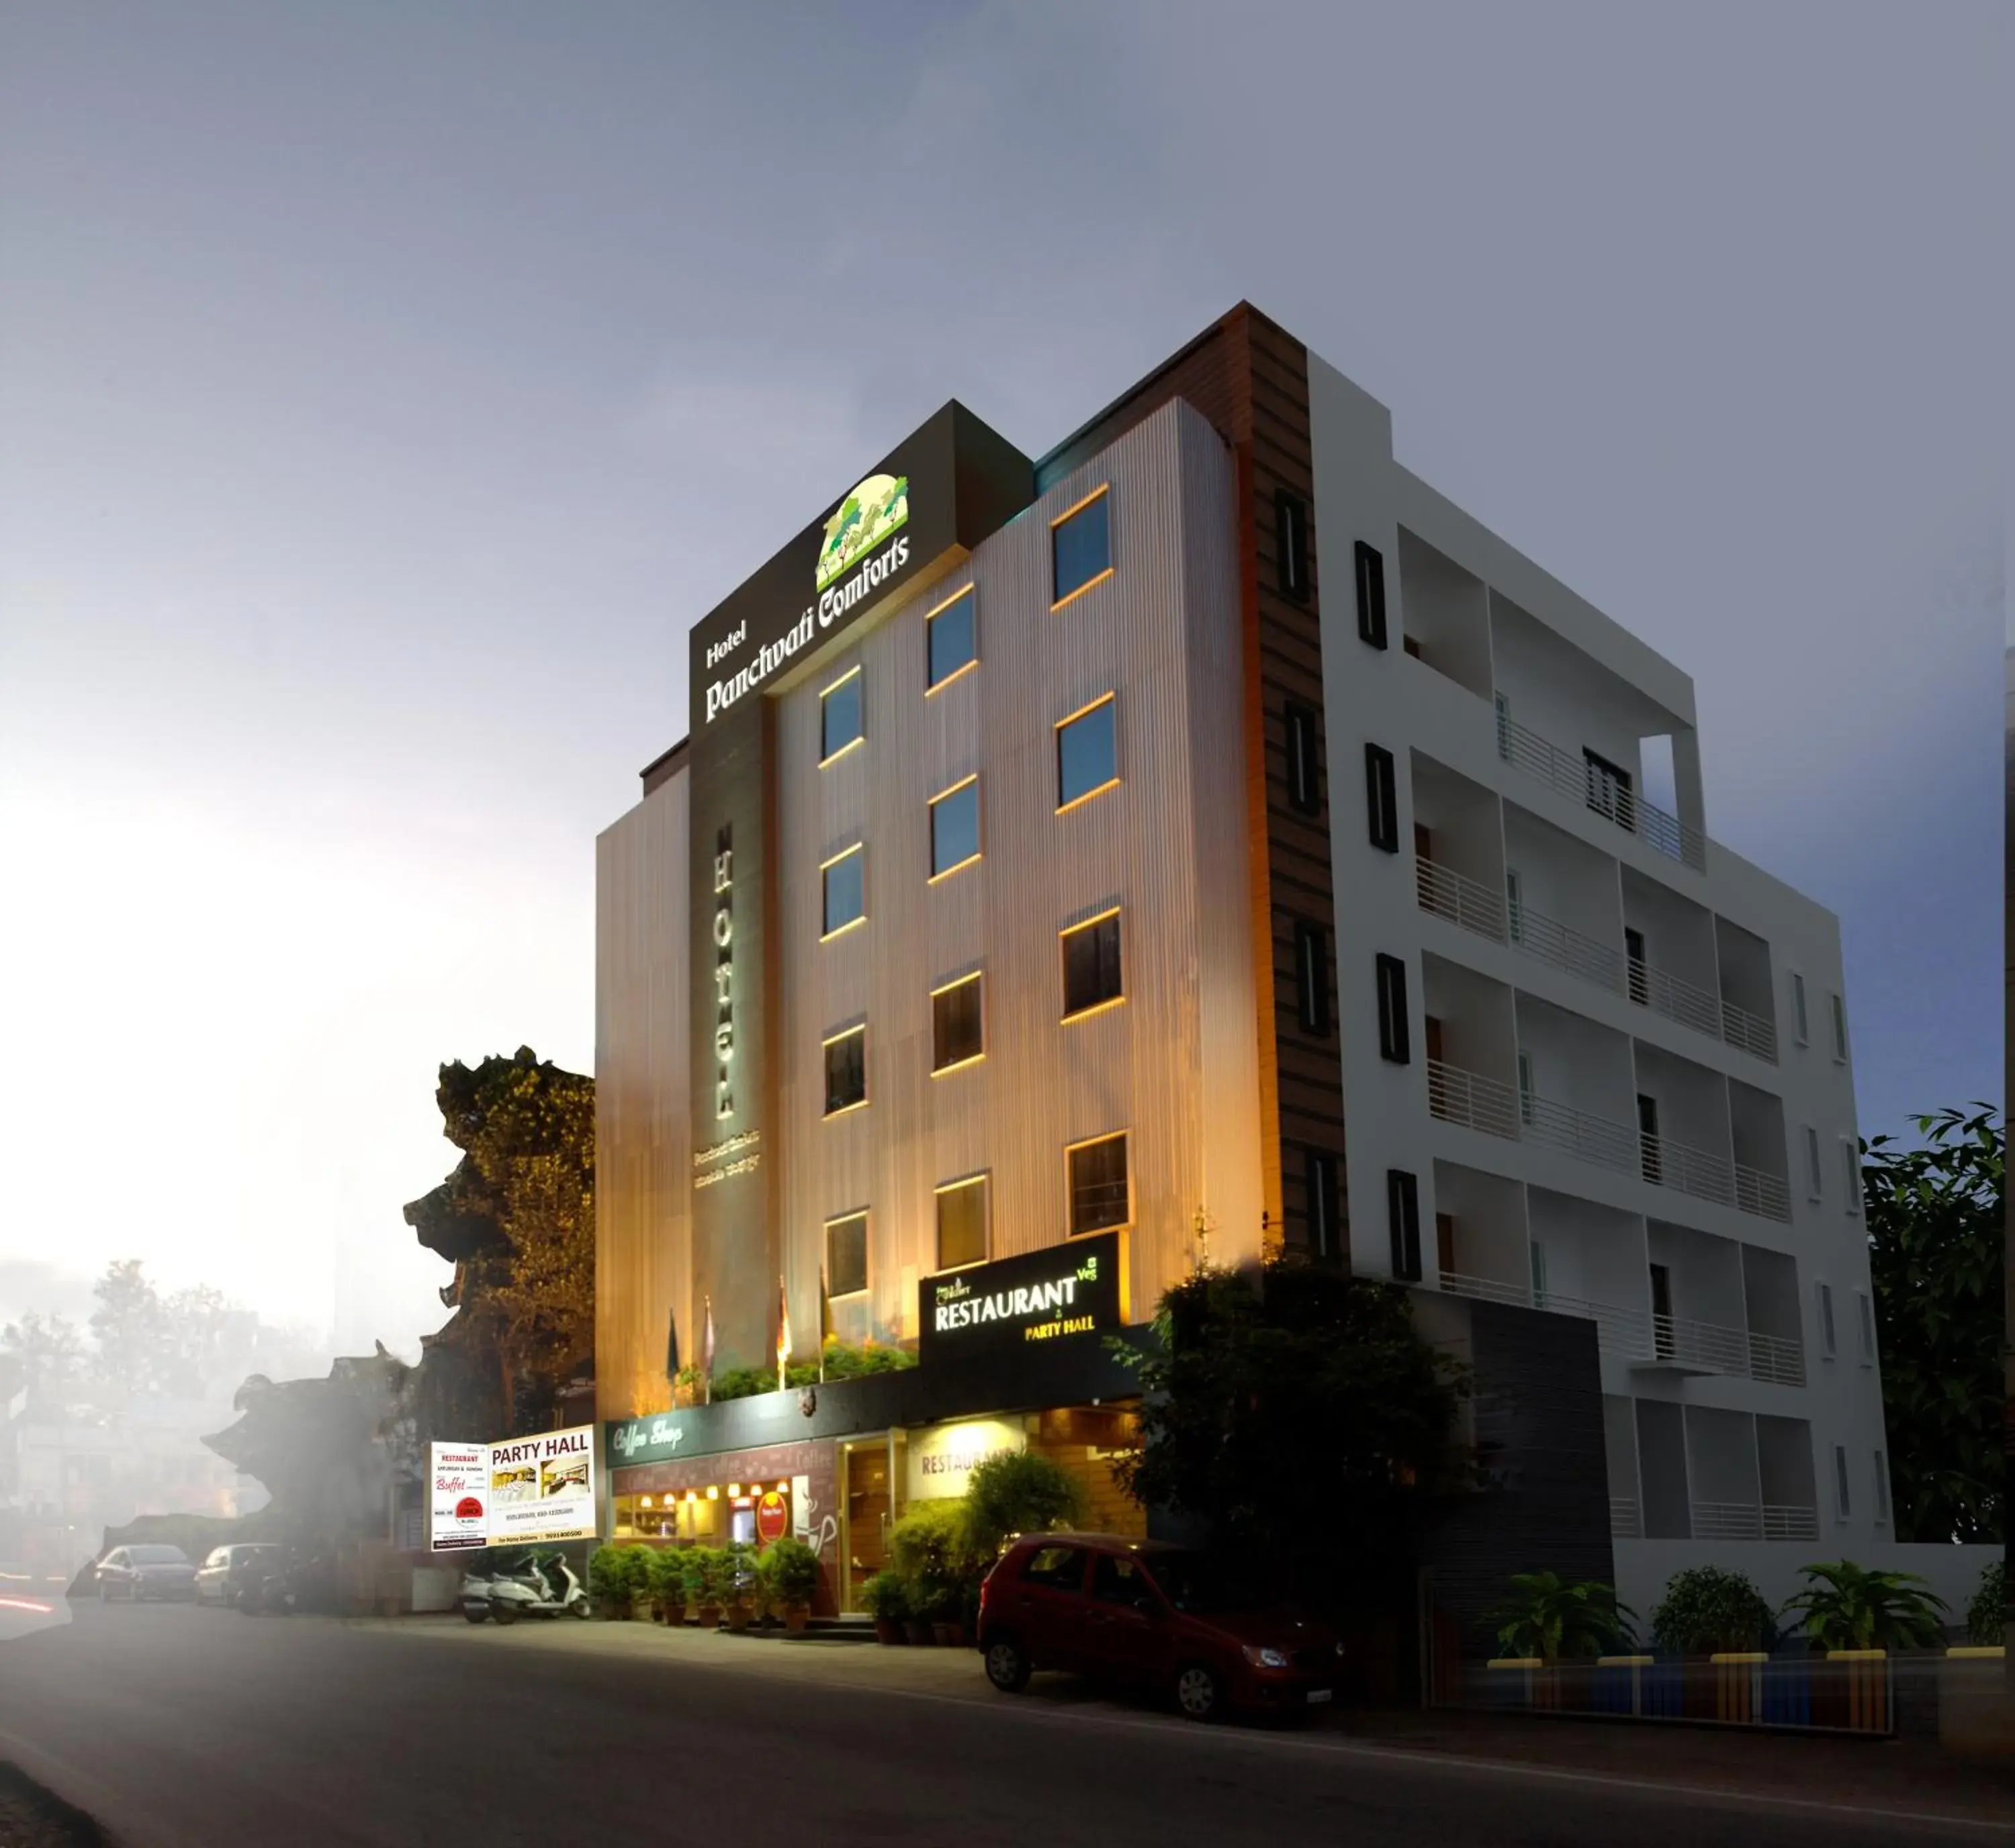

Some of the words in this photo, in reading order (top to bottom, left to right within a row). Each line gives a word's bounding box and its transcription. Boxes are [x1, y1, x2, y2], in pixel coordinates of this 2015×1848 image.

[706, 607, 815, 723] Panchvati
[819, 535, 911, 628] Comforts
[707, 620, 747, 669] Hotel
[714, 850, 734, 1121] HOTEL
[936, 1277, 1078, 1332] RESTAURANT
[1024, 1321, 1061, 1341] PARTY
[1063, 1315, 1095, 1335] HALL
[492, 1442, 541, 1466] PARTY
[545, 1434, 588, 1457] HALL
[613, 1424, 647, 1457] Coffee
[650, 1419, 683, 1451] Shop
[442, 1454, 478, 1463] RESTAURANT
[436, 1477, 465, 1493] Buffet
